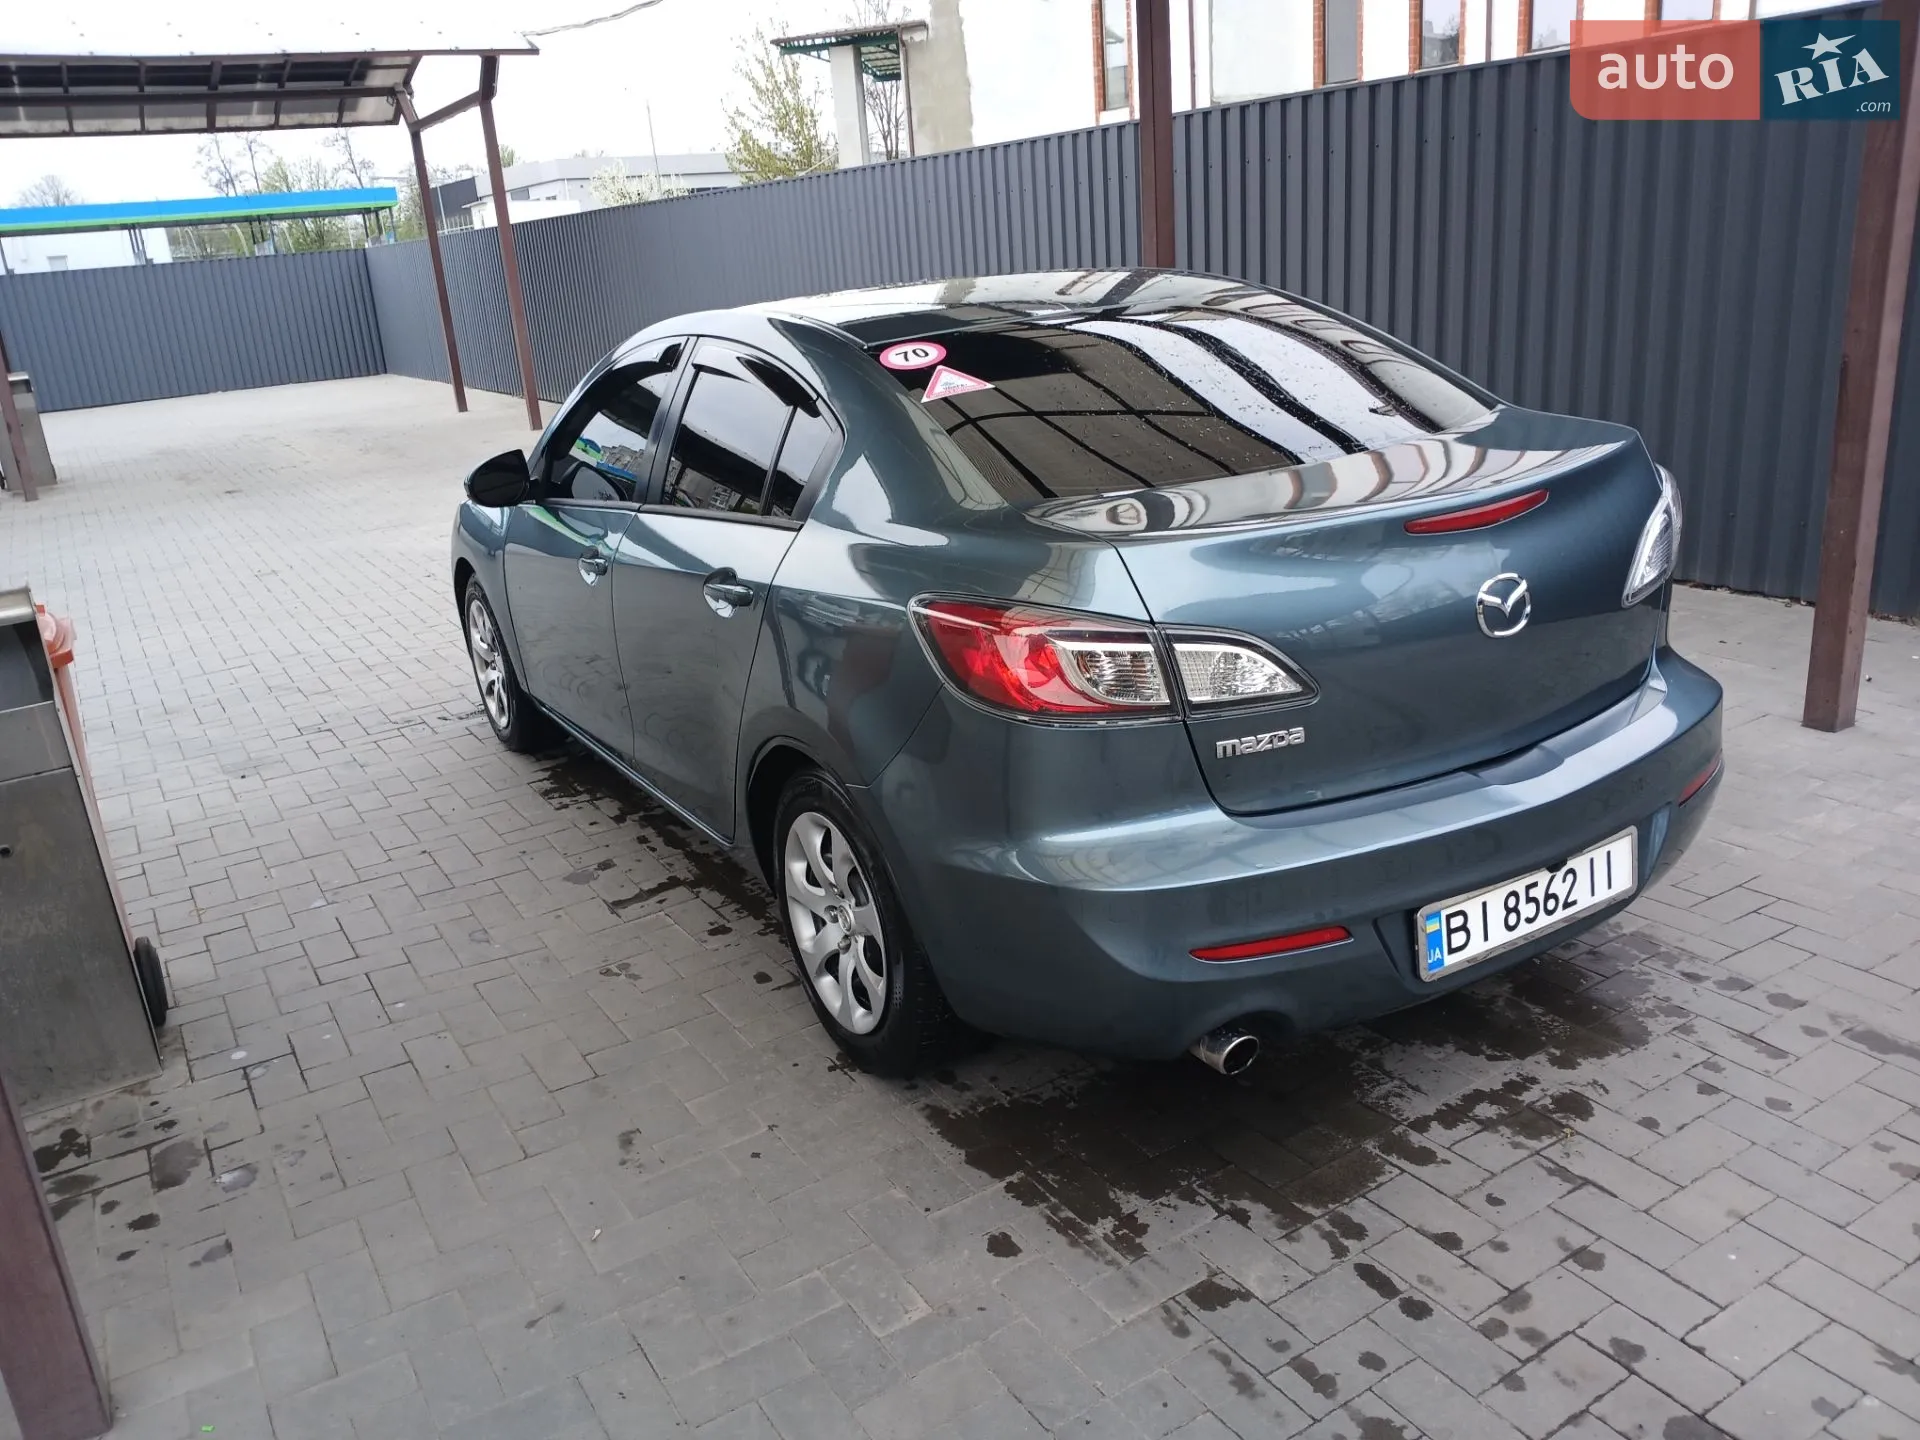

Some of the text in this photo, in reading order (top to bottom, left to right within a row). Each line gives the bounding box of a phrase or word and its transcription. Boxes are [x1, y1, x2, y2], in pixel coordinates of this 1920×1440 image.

[895, 347, 929, 362] 70
[1216, 727, 1305, 758] mazda
[1445, 901, 1489, 955] BI
[1503, 867, 1578, 932] 8562
[1427, 949, 1442, 963] UA
